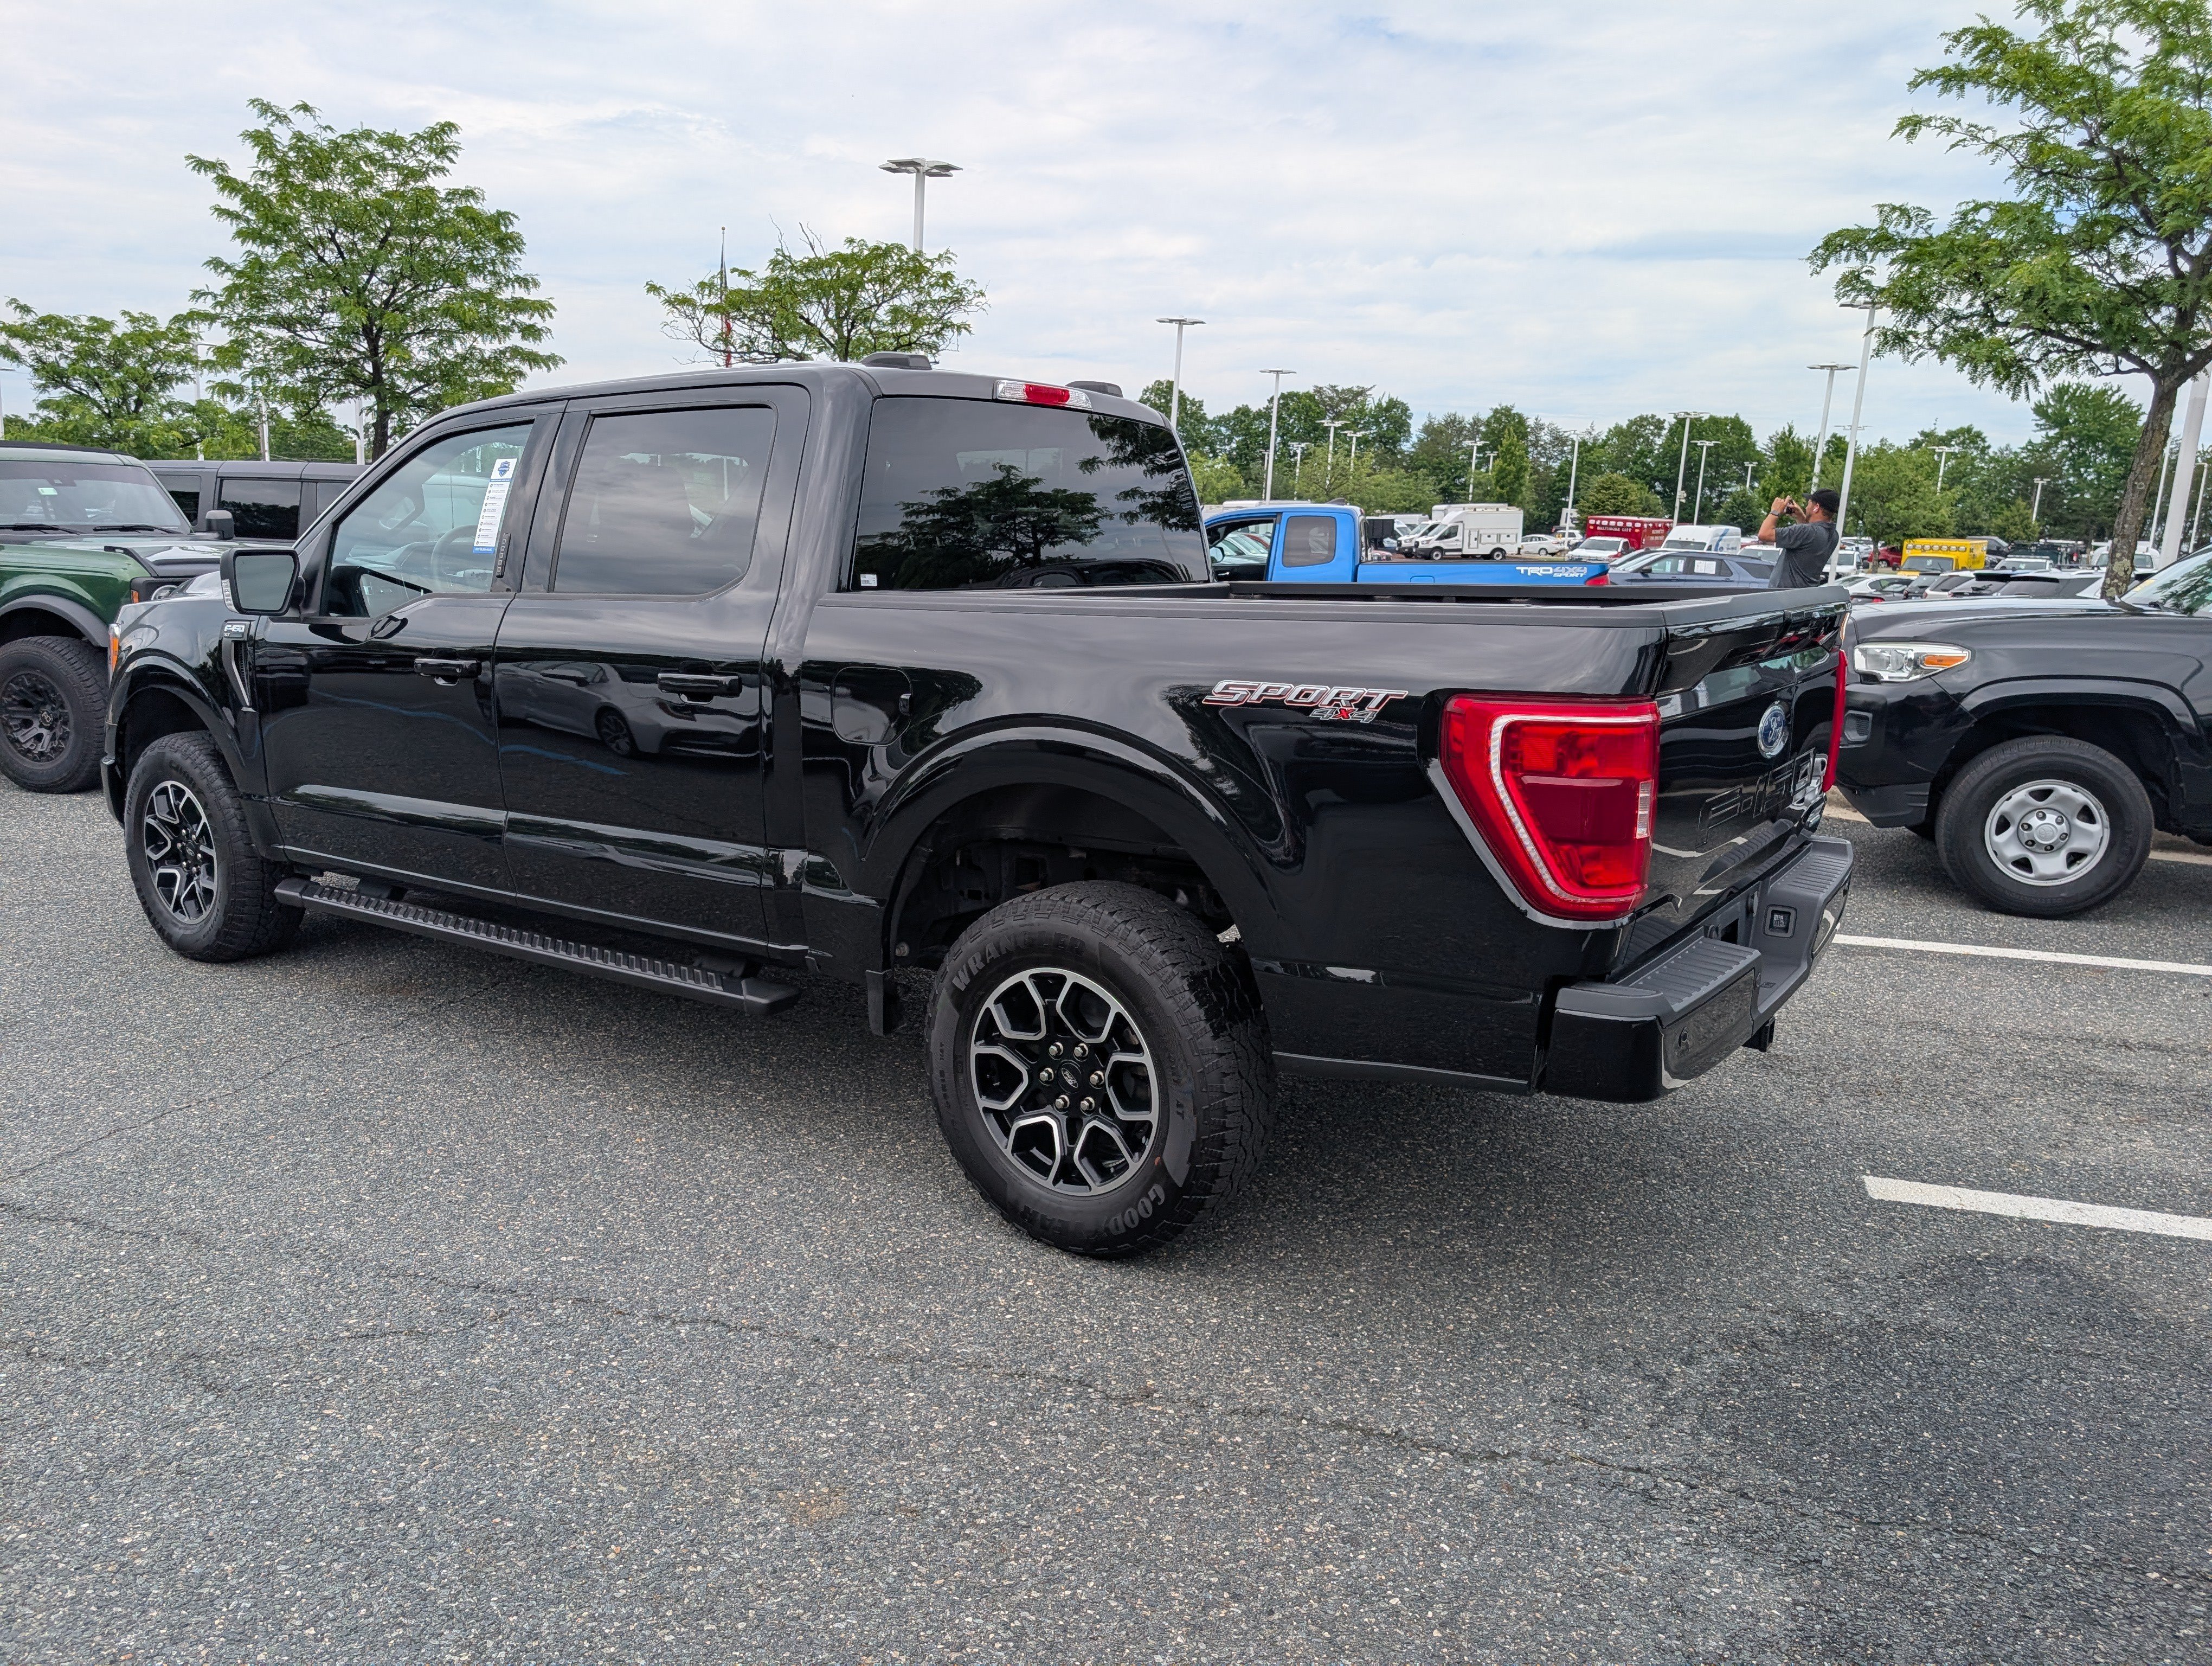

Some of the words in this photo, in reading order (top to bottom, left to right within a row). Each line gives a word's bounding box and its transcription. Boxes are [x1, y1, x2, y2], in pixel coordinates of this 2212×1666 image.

[1515, 566, 1553, 576] TRD
[1201, 680, 1409, 710] SPORT
[952, 930, 1086, 991] WRANGLER
